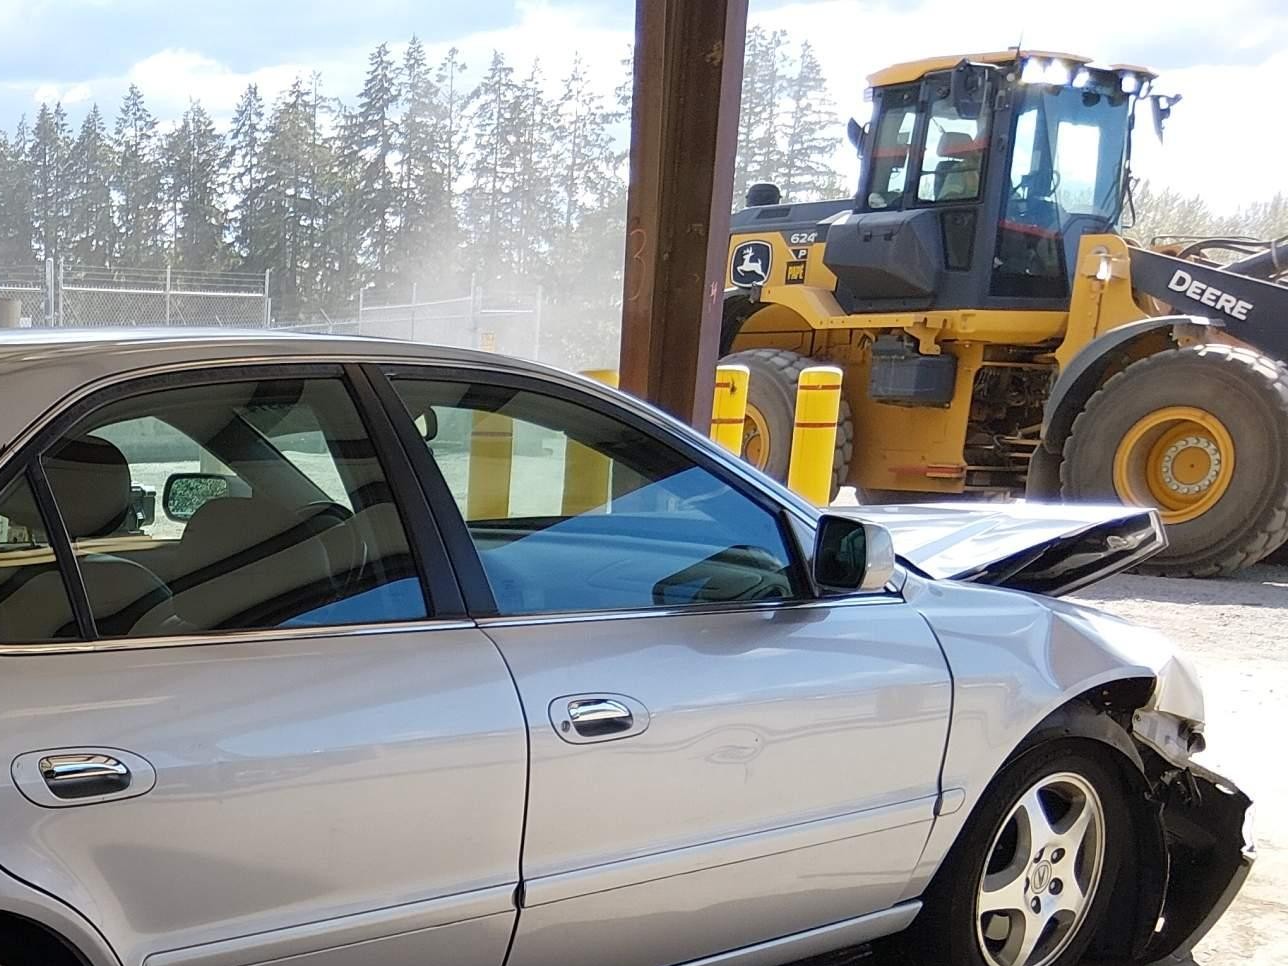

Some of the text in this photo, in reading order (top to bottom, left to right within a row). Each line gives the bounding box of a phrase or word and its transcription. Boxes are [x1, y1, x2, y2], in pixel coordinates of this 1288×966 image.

[791, 233, 817, 244] 624
[798, 250, 807, 259] P
[1167, 269, 1254, 321] DEERE
